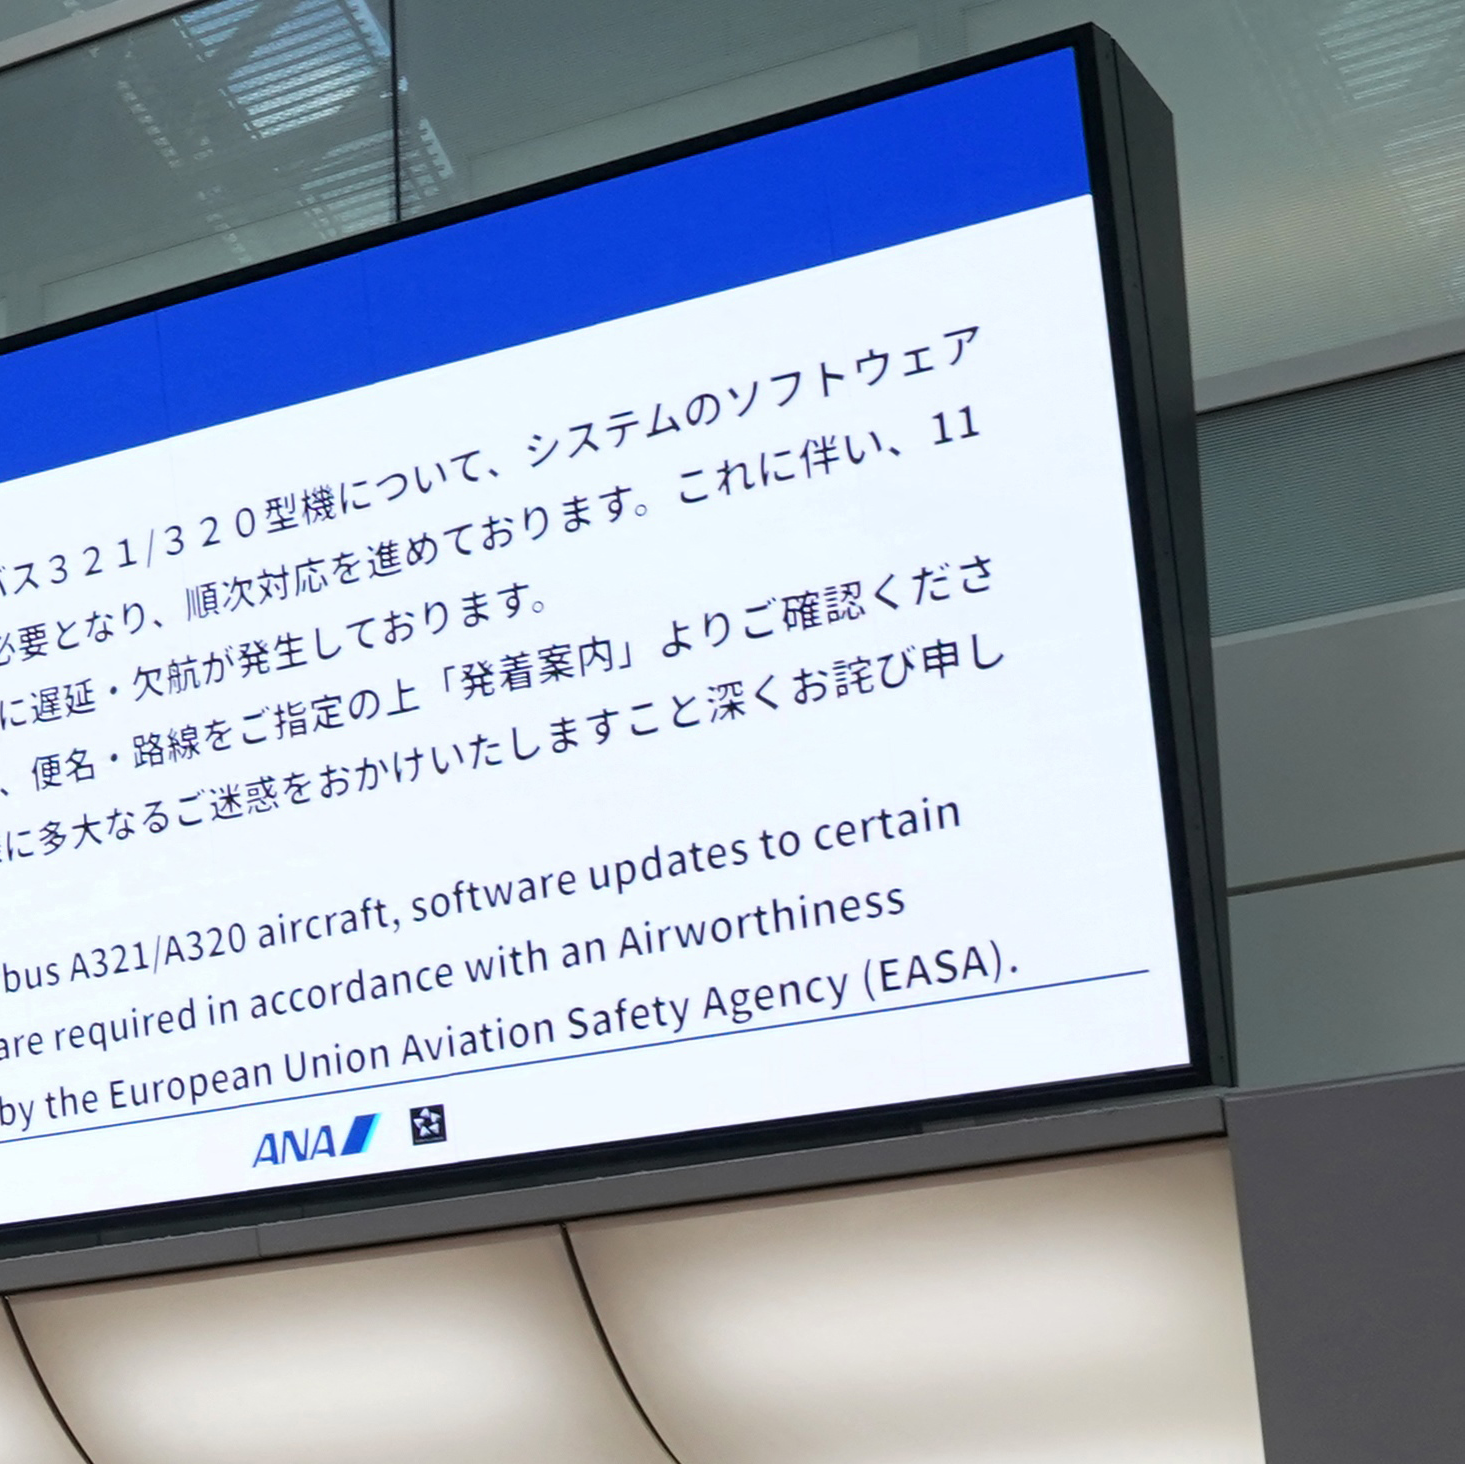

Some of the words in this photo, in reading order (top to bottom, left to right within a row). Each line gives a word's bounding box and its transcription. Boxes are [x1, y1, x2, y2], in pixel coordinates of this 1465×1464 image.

[56, 998, 195, 1051] required
[208, 995, 237, 1025] in
[252, 964, 452, 1018] accordance
[465, 941, 547, 982] with
[563, 939, 604, 967] an
[619, 884, 905, 958] Airworthiness
[71, 923, 245, 981] A321/A320
[260, 898, 399, 948] aircraft,
[413, 871, 575, 921] software
[590, 840, 747, 894] updates
[760, 831, 799, 859] to
[815, 798, 959, 850] certain
[0, 1097, 33, 1131] by
[46, 1087, 97, 1119] the
[111, 1064, 271, 1115] European
[285, 1044, 388, 1081] Union
[403, 1018, 553, 1068] Aviation
[569, 998, 693, 1043] Safety
[704, 974, 850, 1024] Agency
[862, 940, 1020, 1003] (EASA).
[252, 1124, 337, 1167] ANA
